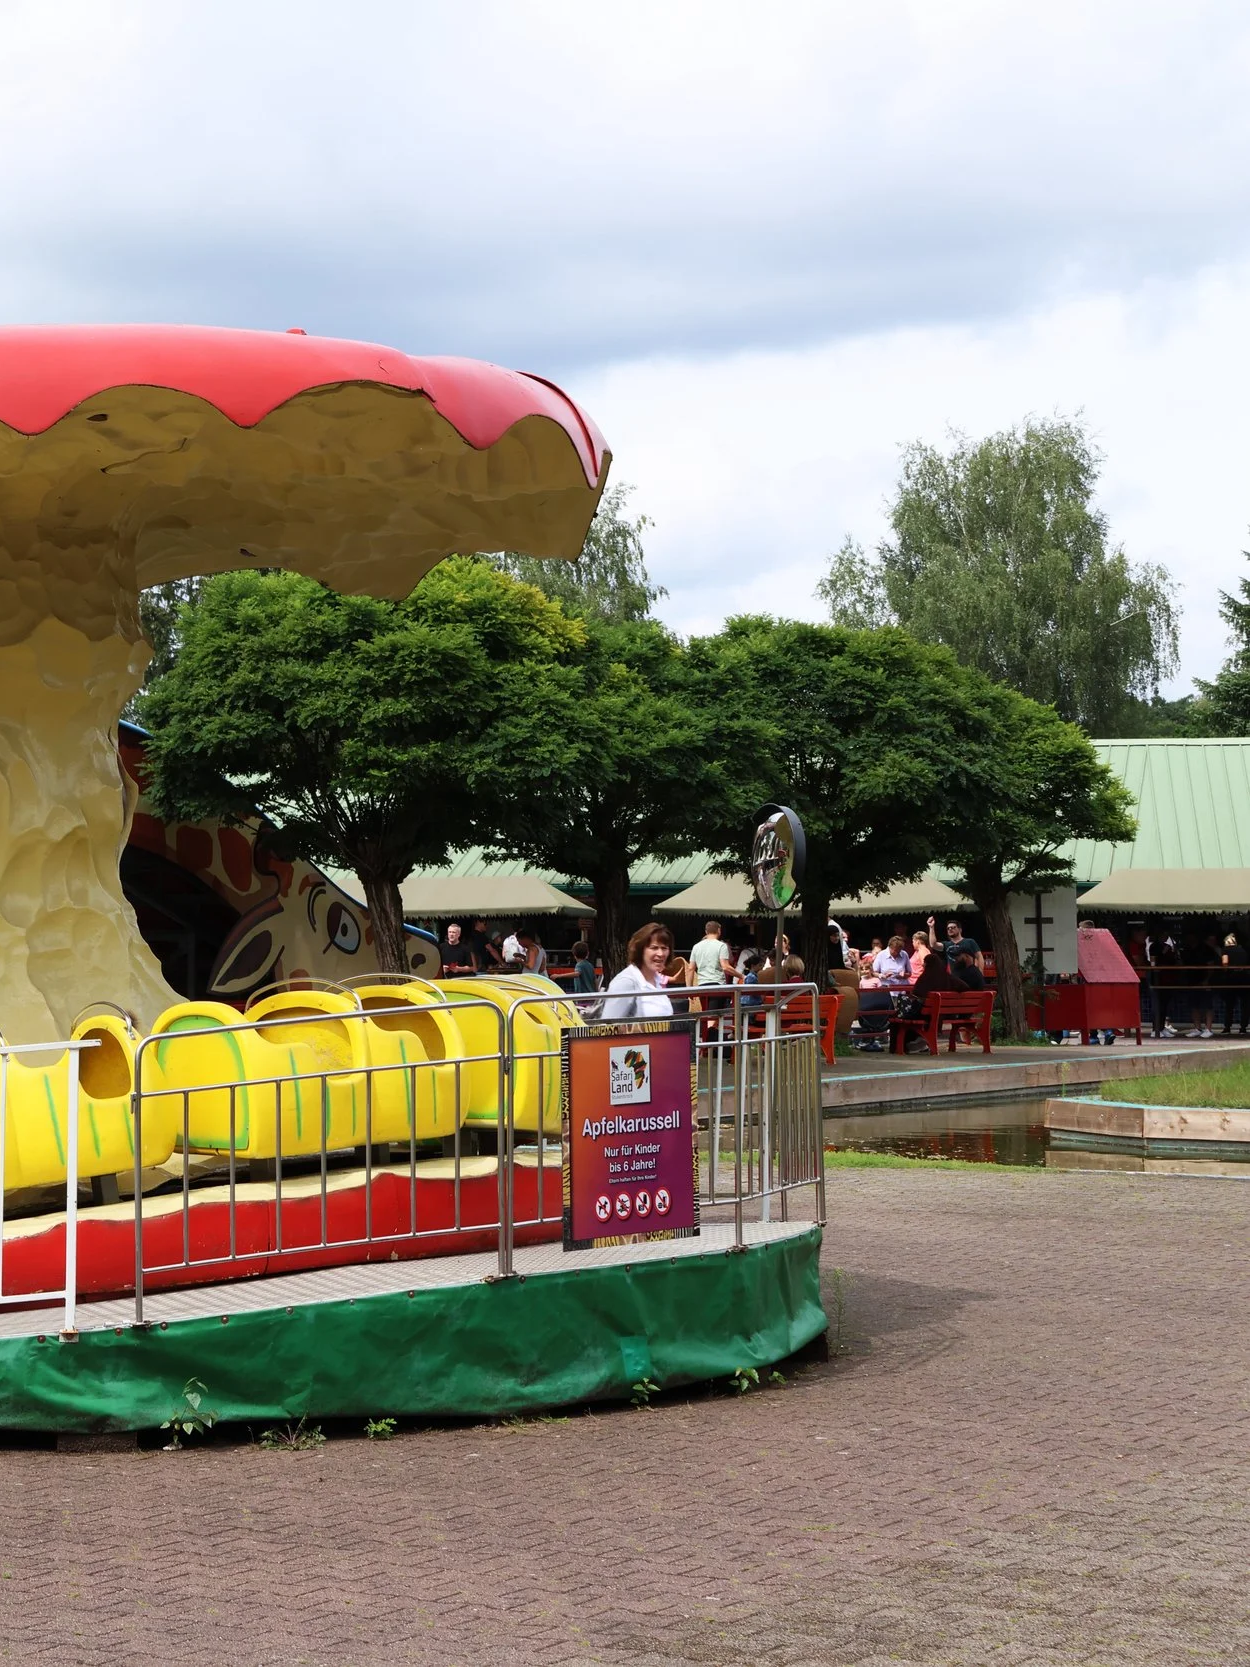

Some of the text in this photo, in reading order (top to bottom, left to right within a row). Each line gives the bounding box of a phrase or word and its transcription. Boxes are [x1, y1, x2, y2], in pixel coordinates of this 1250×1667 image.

[611, 1070, 633, 1081] Safari
[611, 1081, 633, 1093] Land
[582, 1110, 680, 1140] Apfelkarussell
[604, 1143, 660, 1158] Nur für Kinder
[610, 1158, 656, 1173] bis 6 Jahre!
